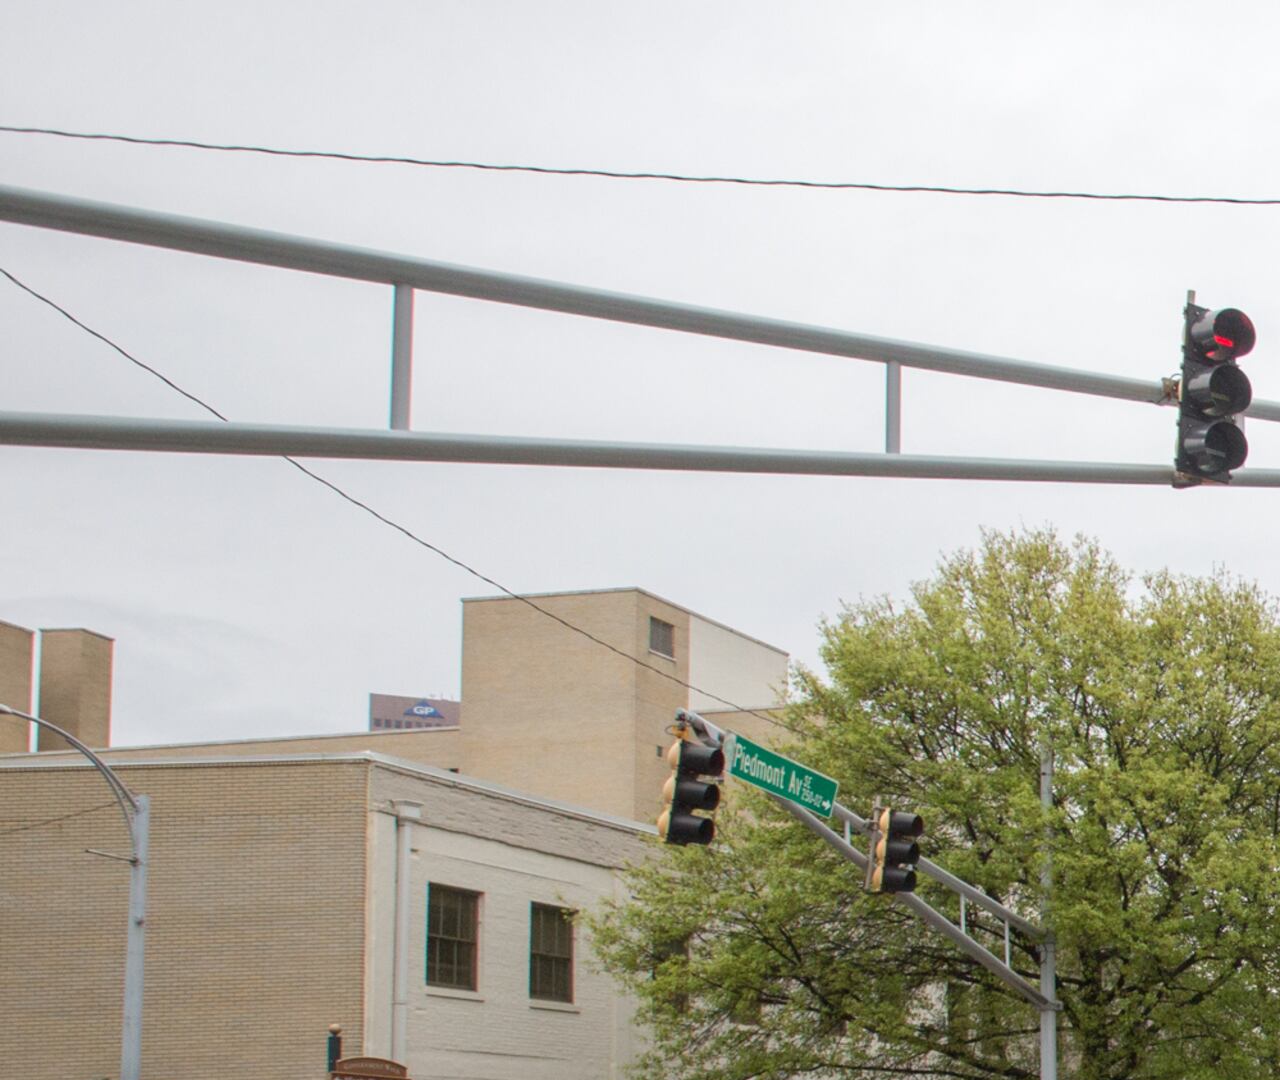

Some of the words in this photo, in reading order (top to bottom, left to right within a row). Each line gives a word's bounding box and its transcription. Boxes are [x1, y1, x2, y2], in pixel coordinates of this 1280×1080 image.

[413, 706, 434, 715] GP
[734, 743, 786, 790] Piedmont
[788, 770, 803, 797] Av
